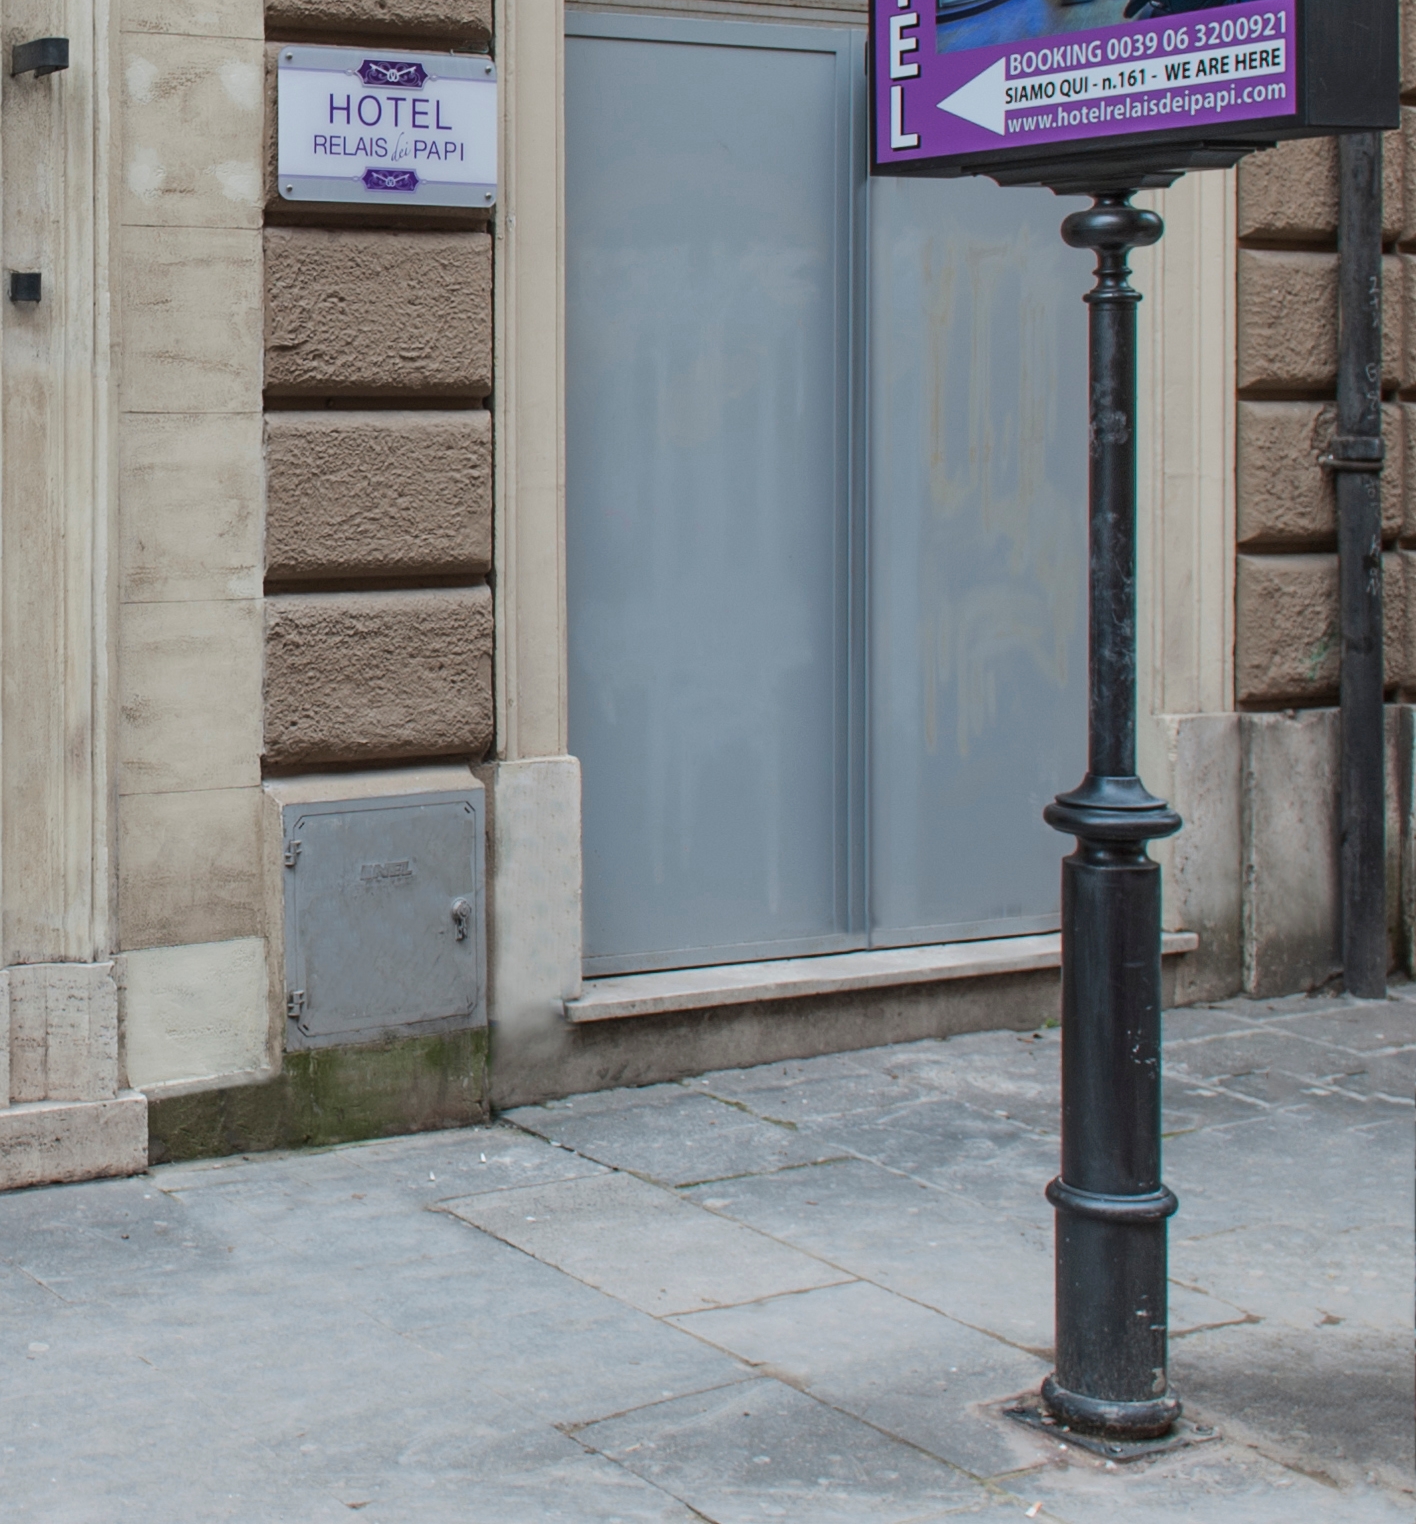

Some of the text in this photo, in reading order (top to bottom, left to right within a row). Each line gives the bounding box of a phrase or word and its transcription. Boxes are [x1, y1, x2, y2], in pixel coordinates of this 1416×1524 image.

[1009, 11, 1286, 76] BOOKING 0039 06 3200921
[1005, 81, 1056, 104] SIAMO
[1059, 76, 1088, 98] QUI
[1102, 68, 1146, 91] n.161
[1165, 62, 1191, 82] WE
[1195, 55, 1229, 78] ARE
[1235, 47, 1281, 72] HERE
[329, 93, 452, 130] HOTEL
[1007, 82, 1286, 133] www.hotelrelaisdeipapi.com
[313, 132, 464, 162] RELAIS dei PAPI
